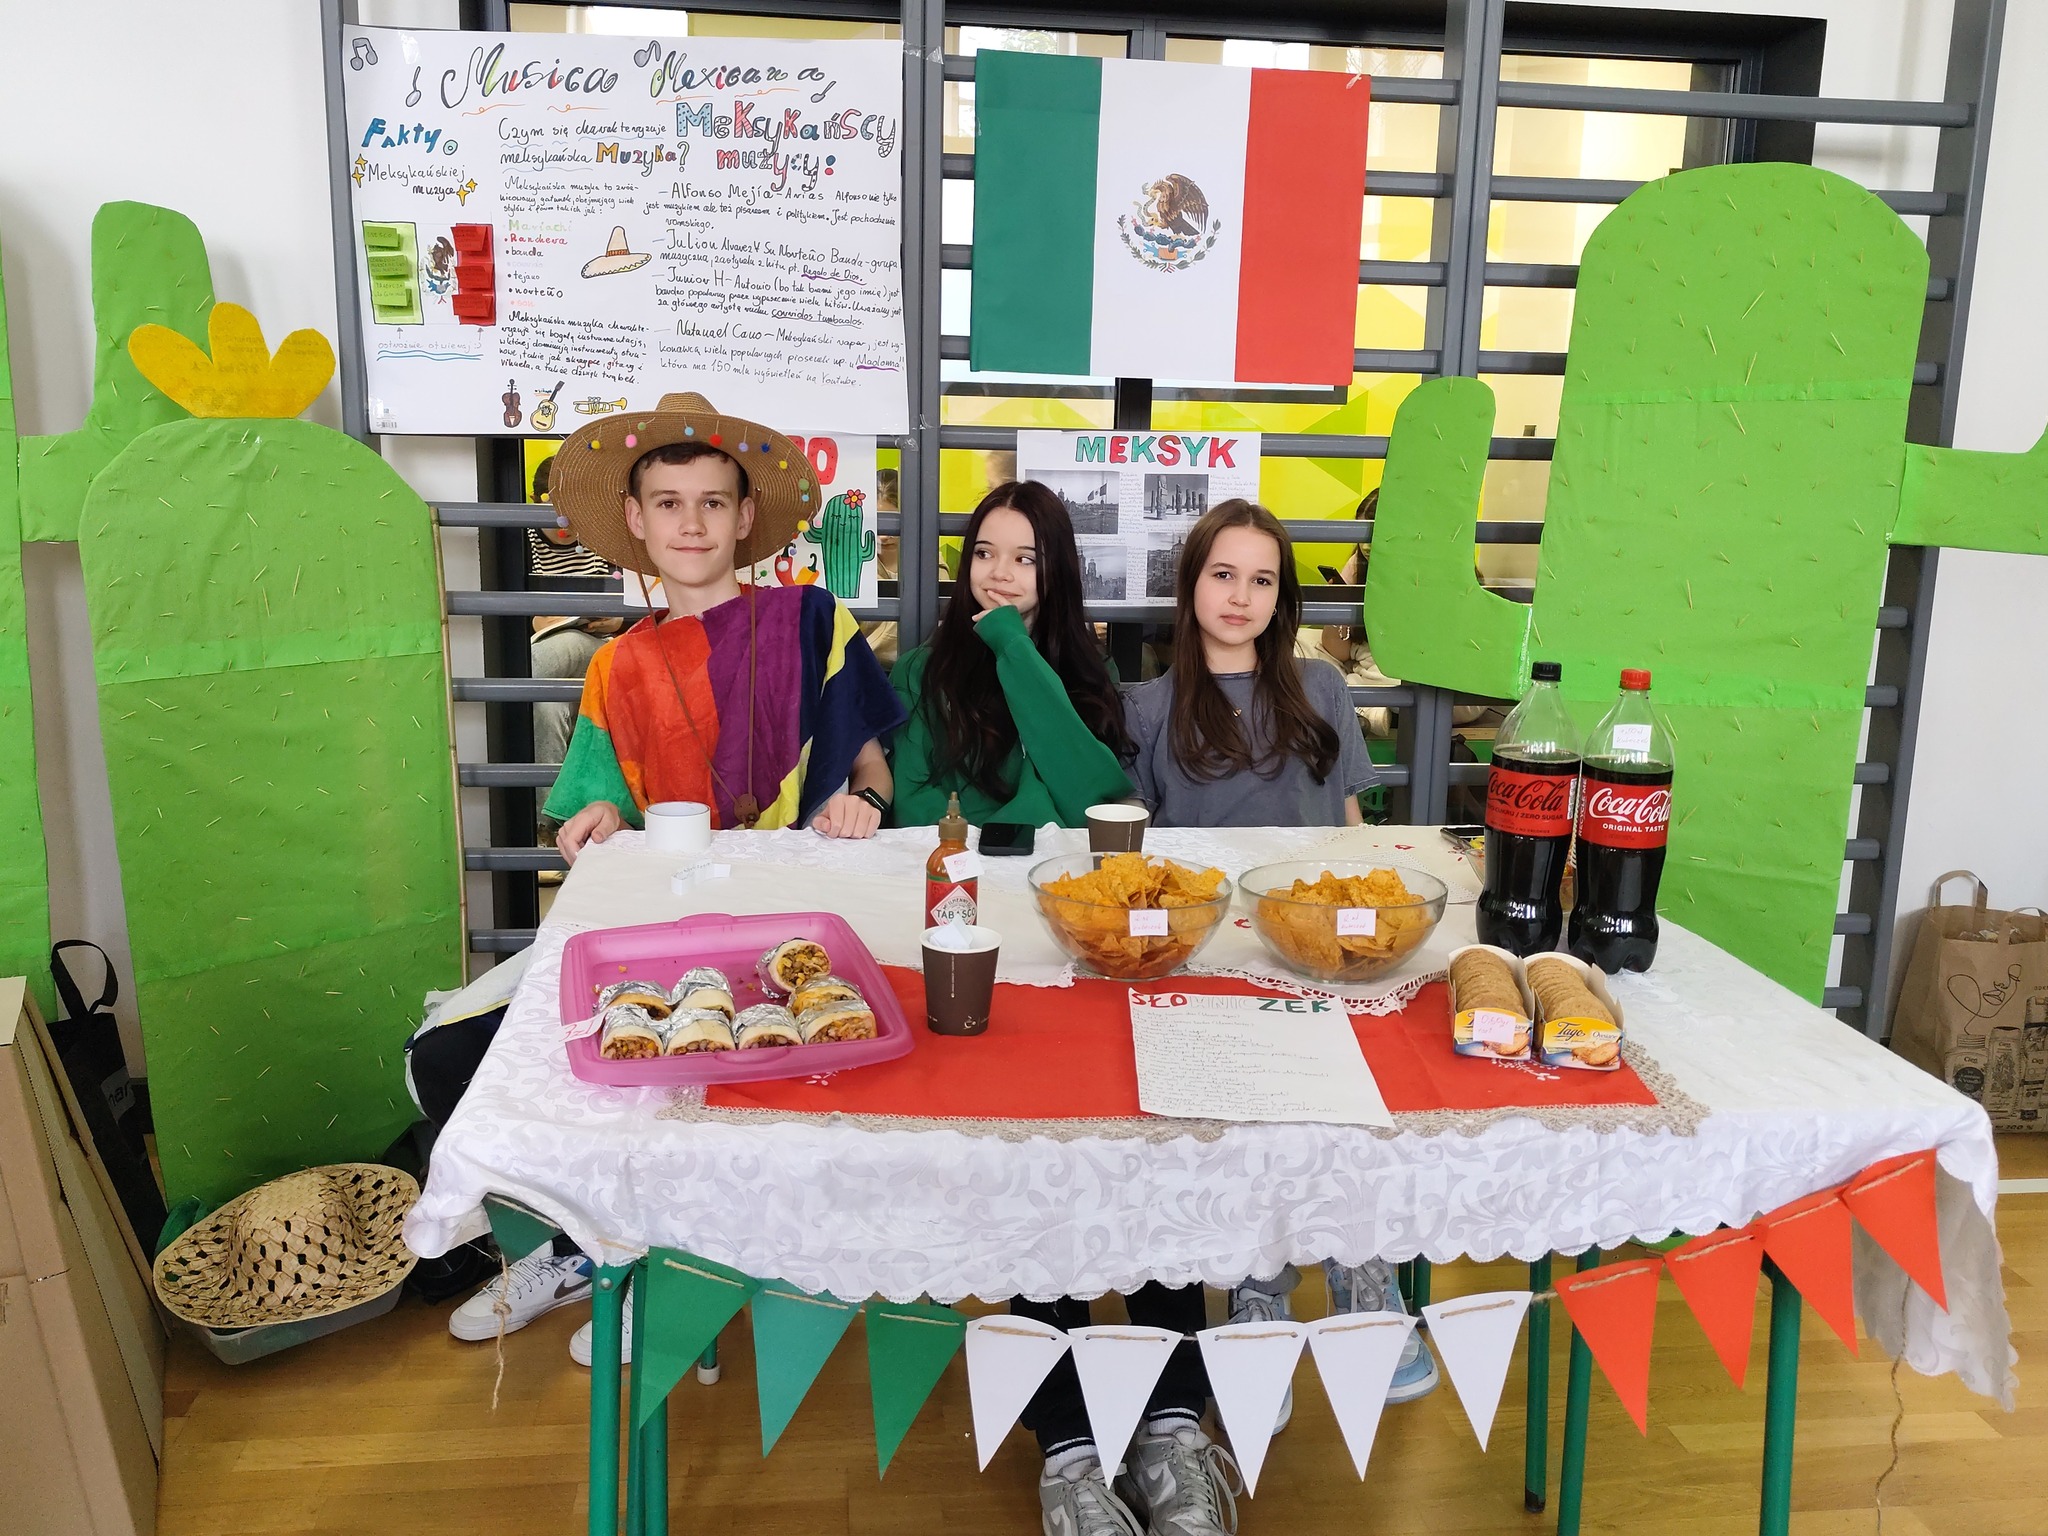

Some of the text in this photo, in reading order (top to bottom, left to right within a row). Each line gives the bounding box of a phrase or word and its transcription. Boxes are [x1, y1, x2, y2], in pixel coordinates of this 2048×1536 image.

[441, 42, 619, 108] Musica
[498, 117, 544, 145] Czym
[552, 123, 569, 137] się
[671, 181, 722, 199] Alfonso
[511, 246, 544, 257] banda
[711, 359, 731, 372] 150
[1075, 434, 1239, 469] MEKSYK
[1589, 787, 1672, 824] Coca-Cola
[1602, 823, 1665, 833] ORIGINAL TASTE
[936, 907, 976, 920] TABSCO
[1556, 1021, 1586, 1041] Tago
